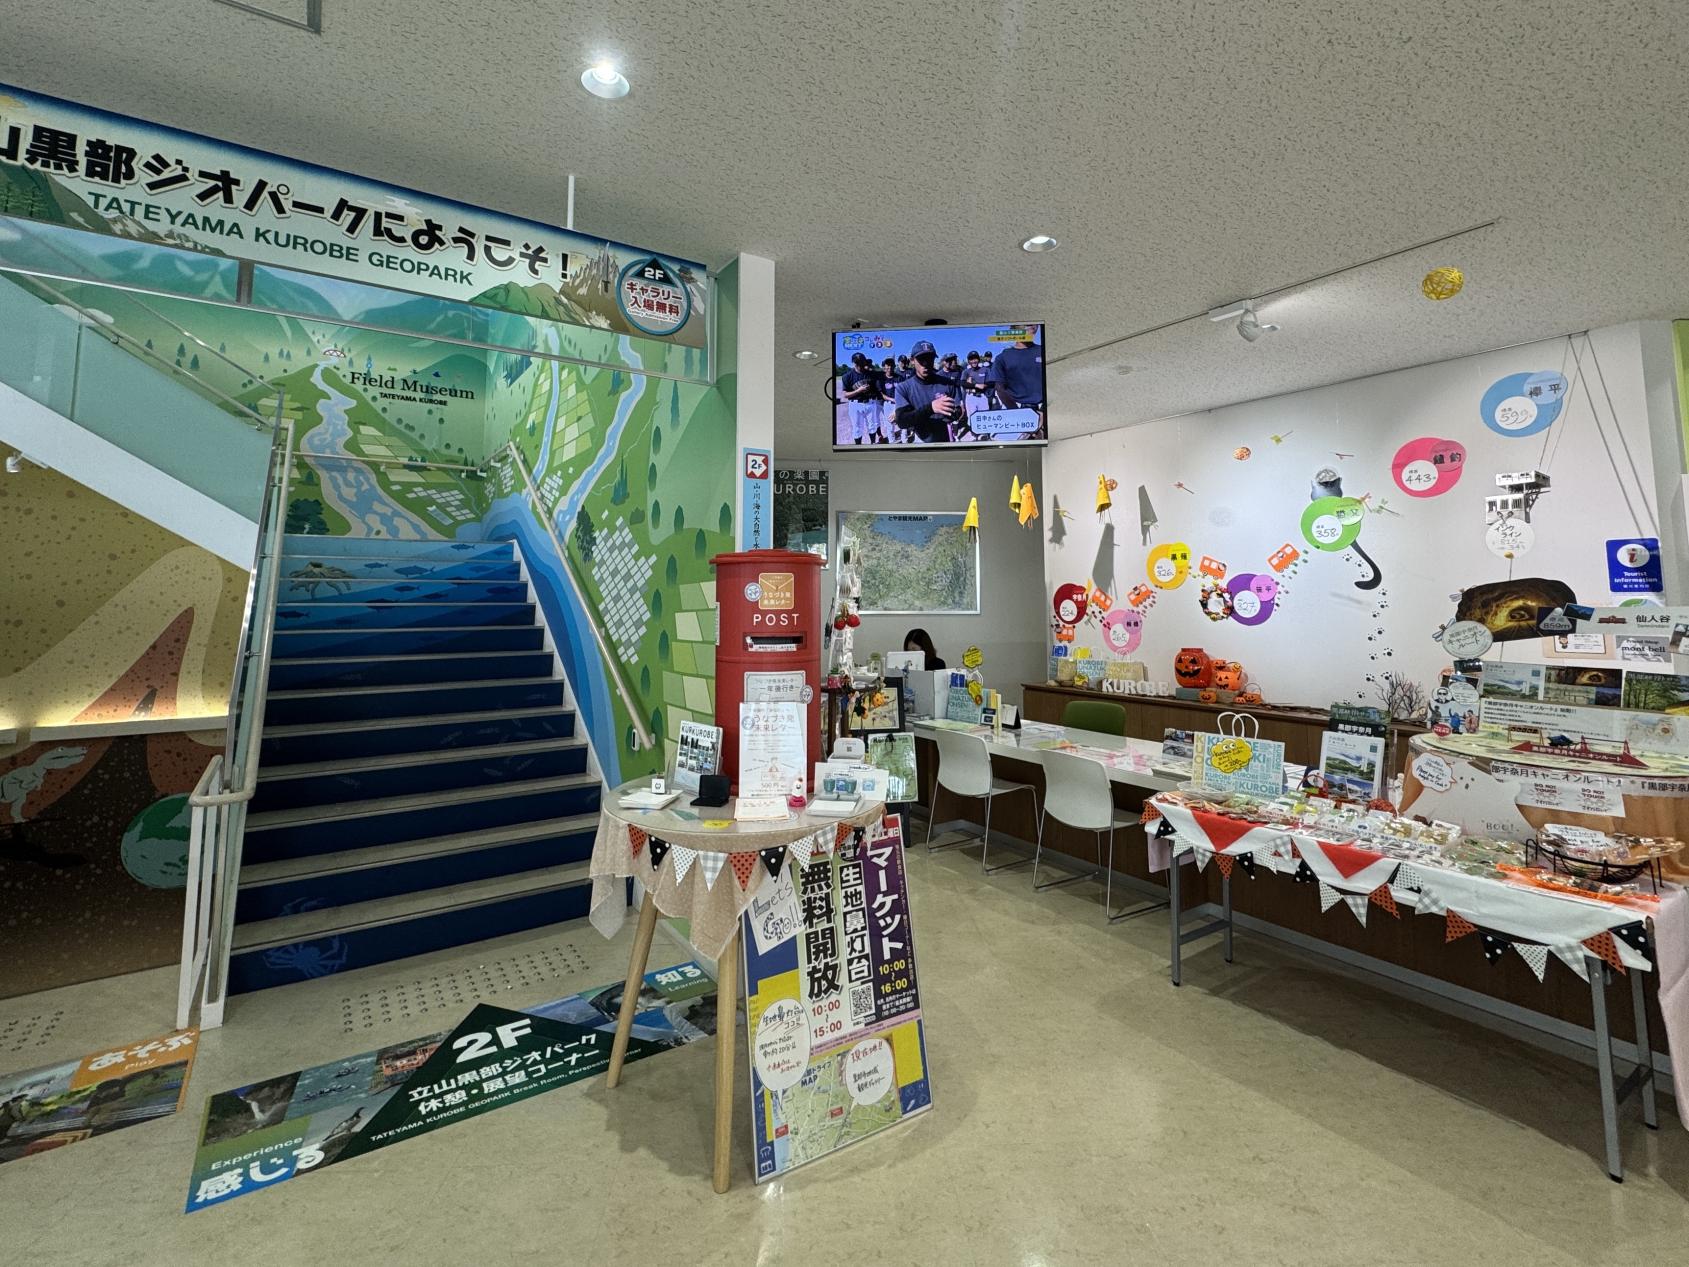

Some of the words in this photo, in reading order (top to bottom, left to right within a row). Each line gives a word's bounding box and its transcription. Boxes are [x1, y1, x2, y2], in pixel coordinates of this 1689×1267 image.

[88, 190, 244, 240] TATEYAMA
[254, 226, 360, 262] KUROBE
[367, 251, 474, 287] GEOPARK
[644, 267, 665, 281] 2F
[626, 281, 683, 301] ギャラリー
[630, 295, 680, 317] 入場無料
[349, 371, 397, 390] Field
[401, 379, 475, 402] Museum
[379, 392, 417, 404] TATEYAMA
[418, 397, 449, 407] KUROBE
[774, 483, 827, 495] UROBE
[752, 613, 800, 626] POST
[1635, 614, 1671, 623] 仙人谷
[1102, 678, 1169, 696] KUROBE
[1238, 781, 1281, 795] KUROBE
[867, 845, 904, 960] マーケット
[799, 861, 841, 1000] 無料開放
[841, 862, 873, 983] 生地鼻灯台
[655, 964, 702, 986] 知る
[879, 959, 906, 975] 10:00
[668, 977, 709, 992] Learning
[881, 978, 908, 994] 16:00
[811, 999, 841, 1017] 10:00
[813, 1020, 843, 1038] 15:00
[452, 1018, 533, 1064] 2F
[87, 1031, 196, 1072] あそぶ
[124, 1058, 157, 1070] Play
[408, 1033, 597, 1102] 立山黒部ジオパーク
[418, 1049, 600, 1116] 休憩・展望コーナー
[800, 1074, 818, 1088] MAP
[370, 1120, 424, 1142] TATEYAMA
[426, 1106, 466, 1124] KUROBE
[468, 1091, 512, 1110] GEOPARK
[513, 1082, 539, 1095] Break
[540, 1074, 568, 1085] Room,
[568, 1058, 610, 1076] Perspectiv
[211, 1137, 303, 1171] Experience
[194, 1142, 326, 1203] 感じる
